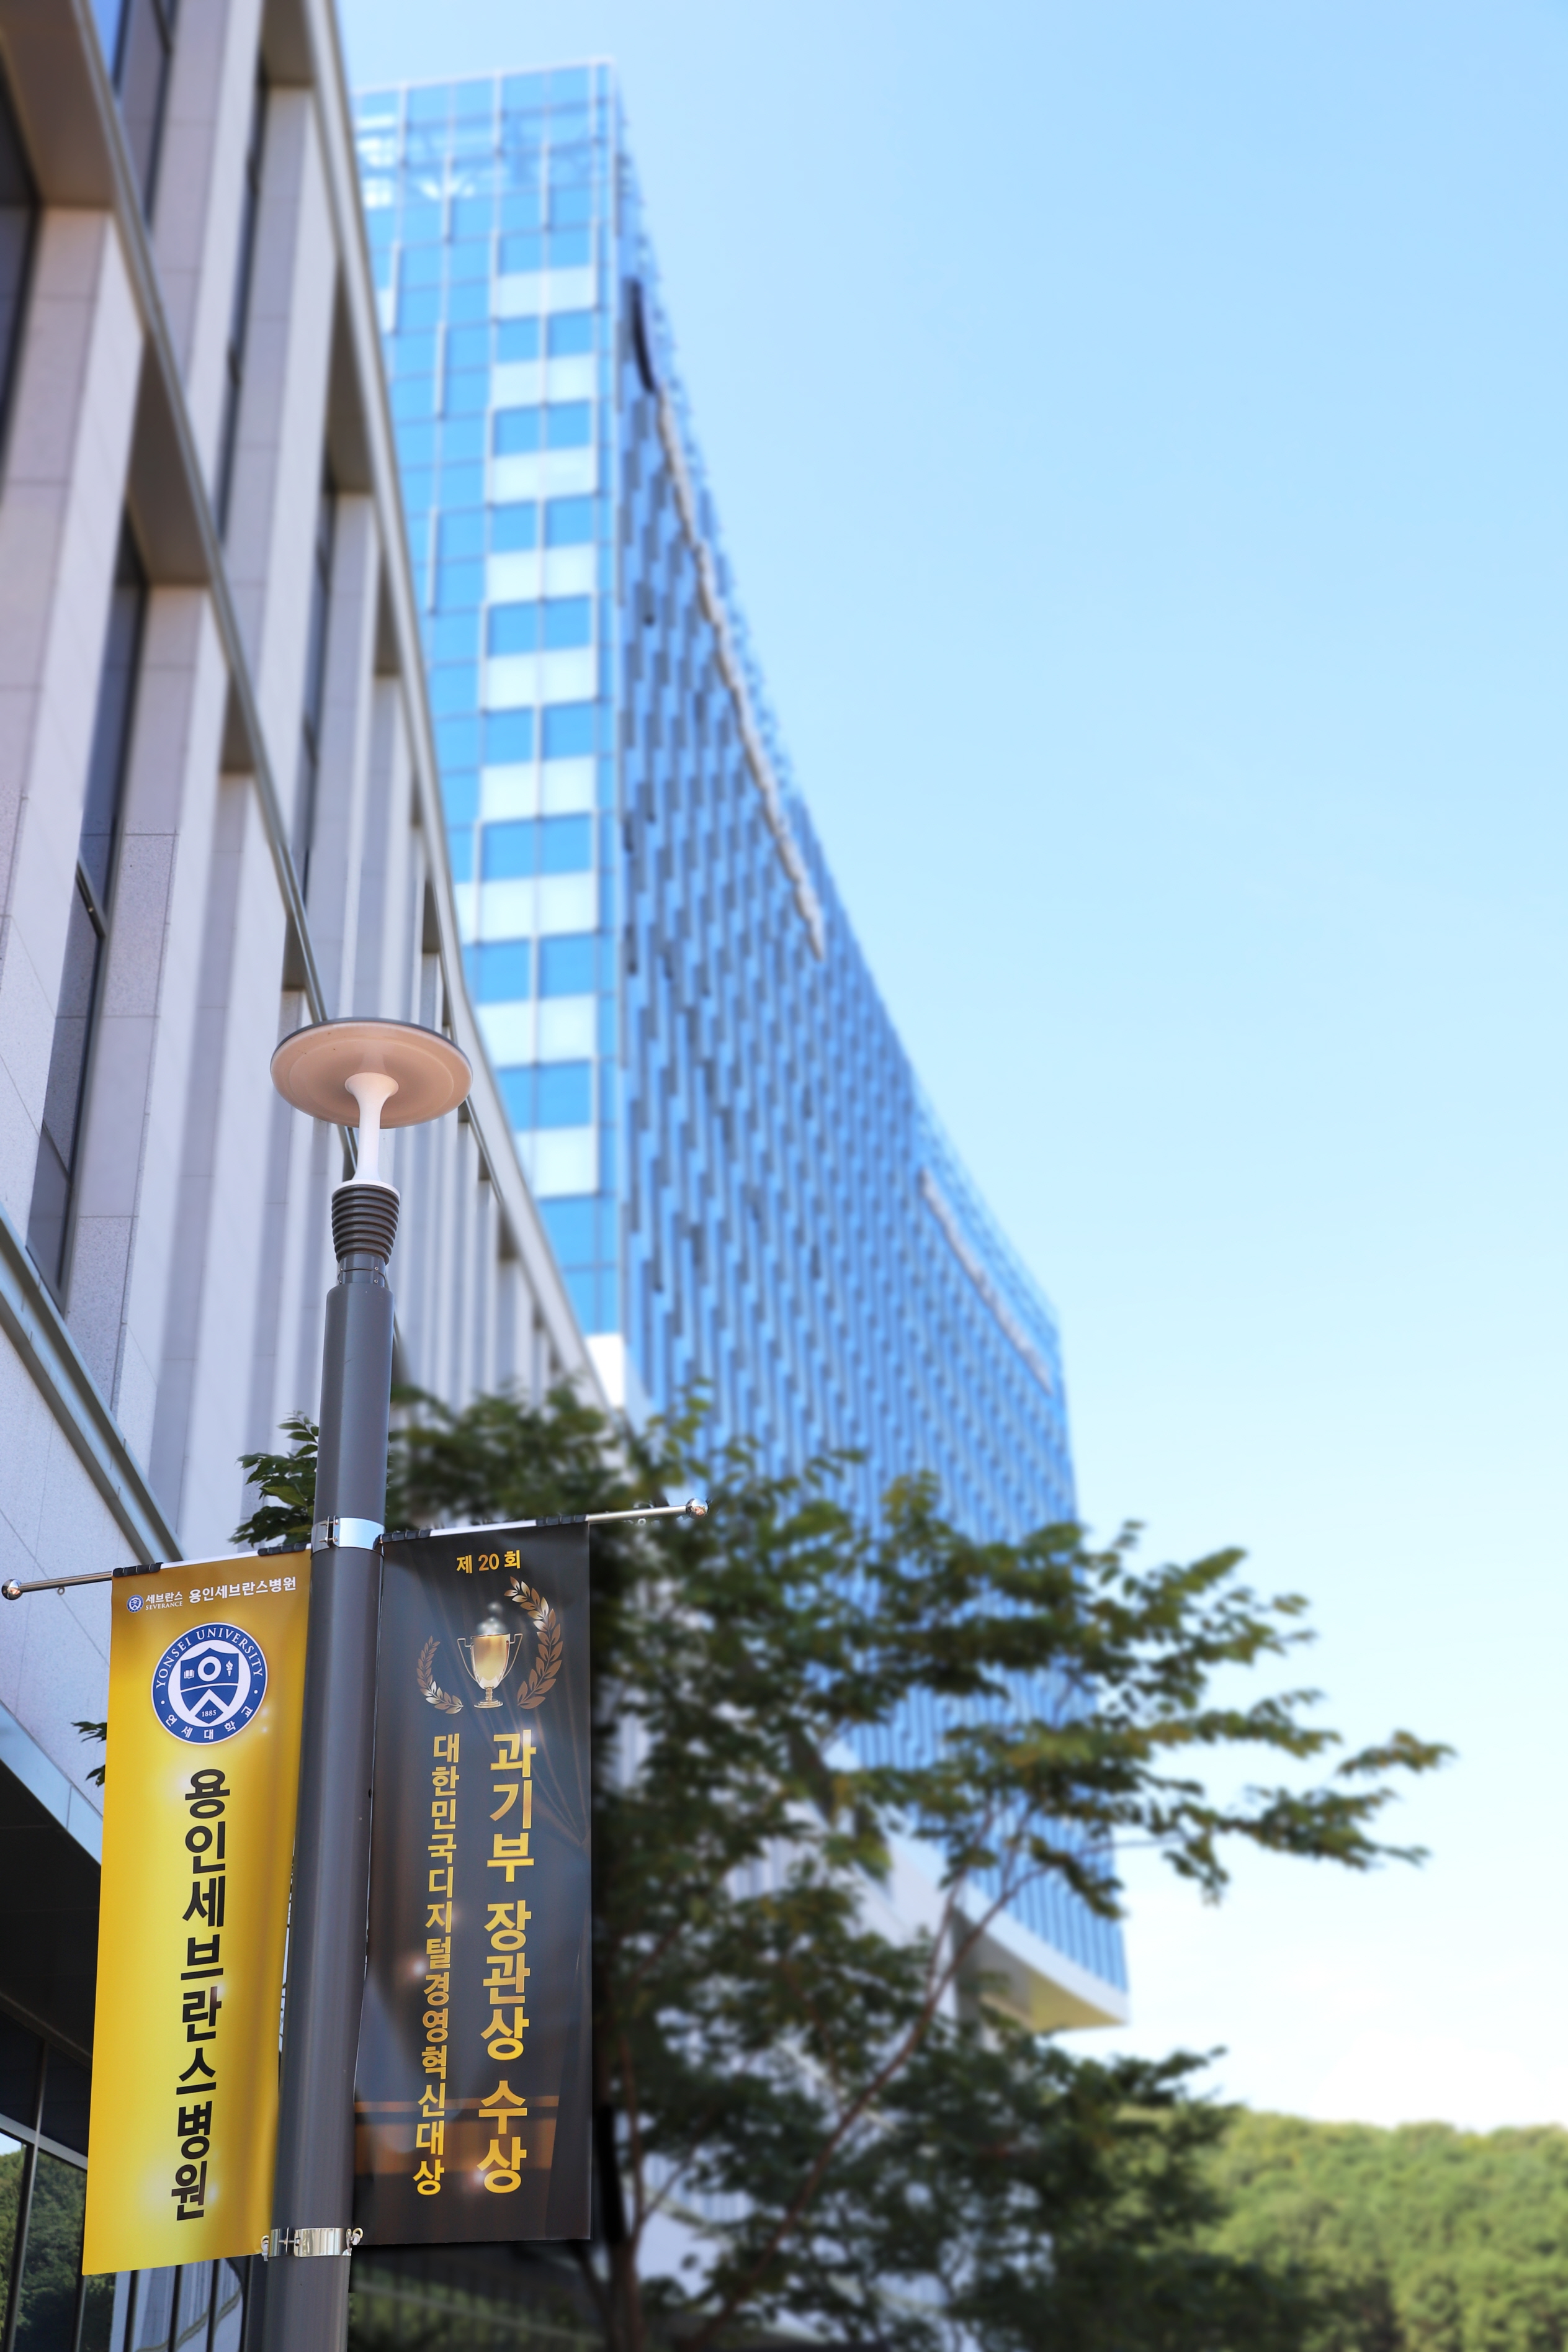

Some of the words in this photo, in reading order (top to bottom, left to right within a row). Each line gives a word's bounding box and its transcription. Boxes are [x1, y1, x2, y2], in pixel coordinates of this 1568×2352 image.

[456, 1555, 473, 1574] 제
[145, 1591, 182, 1604] 세브란스
[145, 1600, 183, 1610] SEVERANCE
[189, 1576, 297, 1604] 용인세브란스병원
[156, 1636, 192, 1689] YONSEI
[196, 1627, 263, 1677] UNIVERSITY
[165, 1705, 253, 1740] 연세대학교
[201, 1709, 217, 1717] 1885
[486, 1729, 537, 1882] 과기부
[412, 1733, 460, 2196] 대한민국디지털경영혁신대상
[480, 1900, 532, 2061] 장관상
[171, 1769, 230, 2221] 용인세브란스병원
[477, 2080, 527, 2194] 수상
